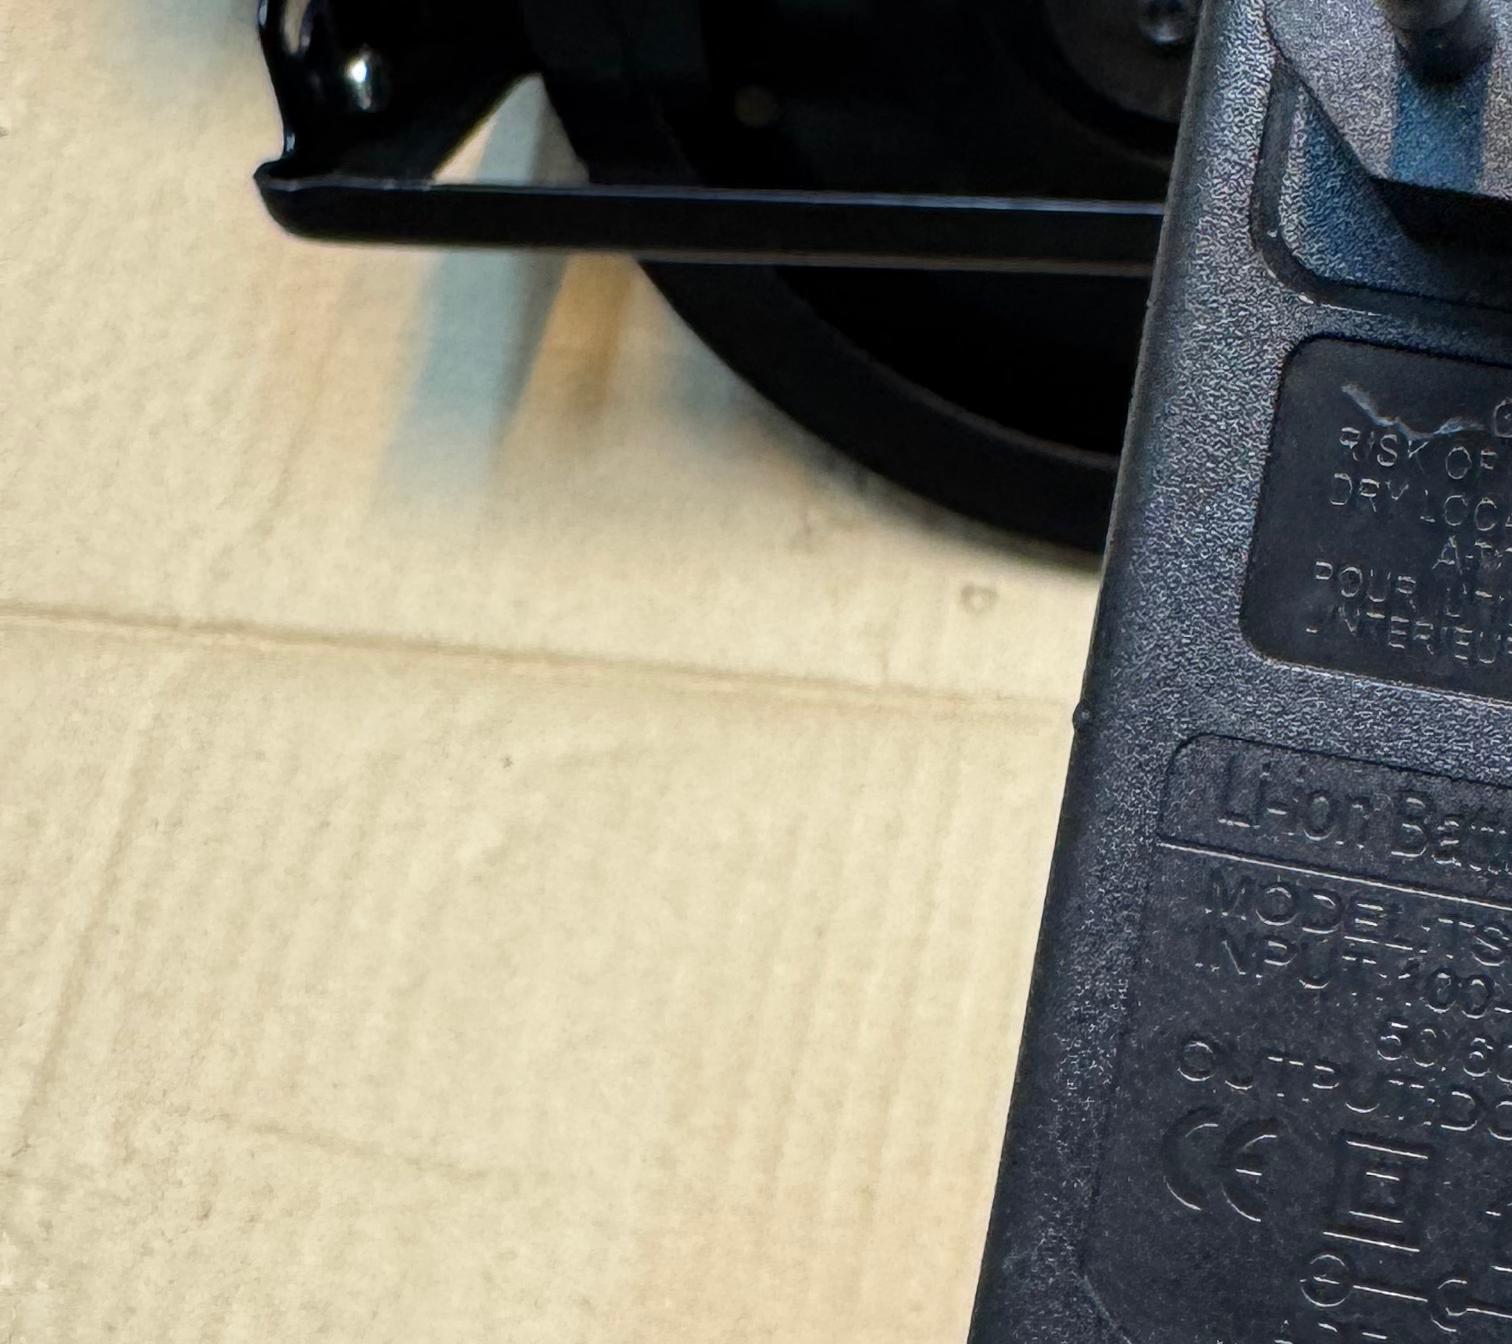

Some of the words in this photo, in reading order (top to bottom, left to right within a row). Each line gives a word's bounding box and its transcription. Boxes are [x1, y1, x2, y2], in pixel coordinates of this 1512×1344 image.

[1334, 424, 1431, 474] RISK
[1441, 442, 1498, 486] OF
[1326, 471, 1409, 518] DRY
[1309, 559, 1418, 609] POUR
